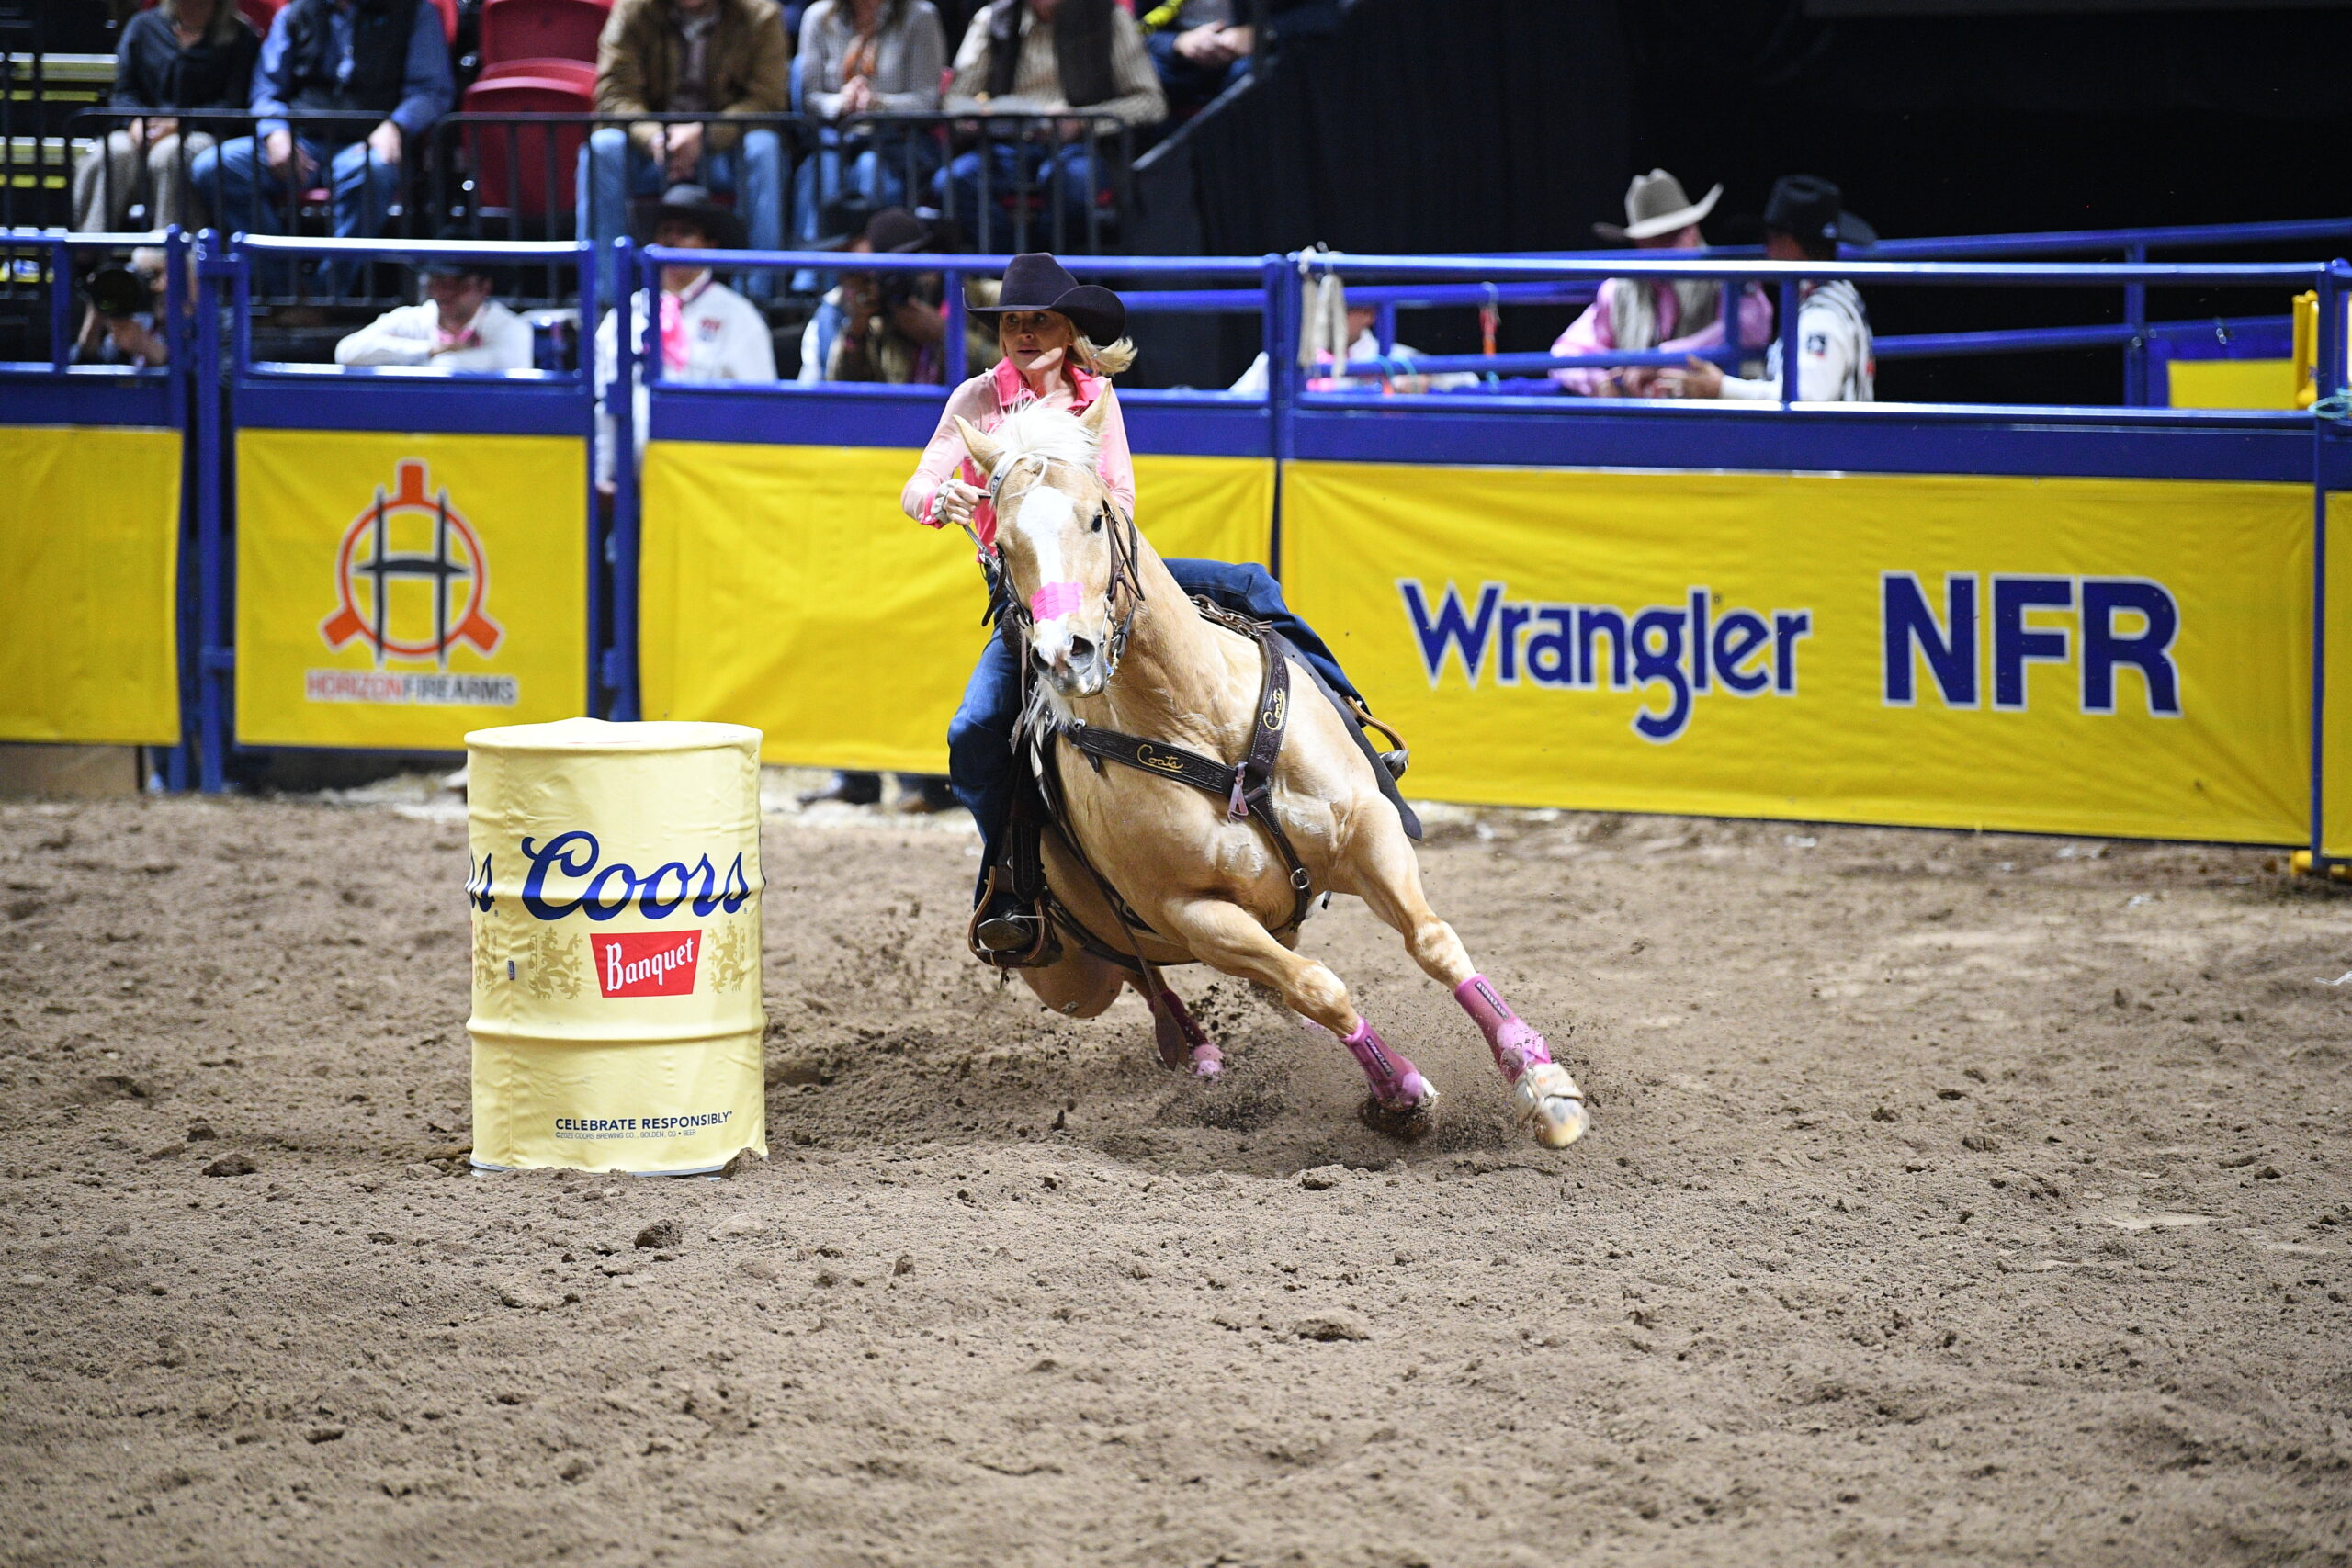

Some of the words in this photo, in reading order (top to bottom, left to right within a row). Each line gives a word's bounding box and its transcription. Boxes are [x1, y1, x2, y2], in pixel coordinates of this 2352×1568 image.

[1396, 577, 1810, 743] Wrangler
[1881, 572, 2183, 716] NFR
[1136, 744, 1184, 773] Coats
[521, 830, 752, 921] Coors
[605, 937, 694, 991] Banquet
[555, 1118, 637, 1131] CELEBRATE
